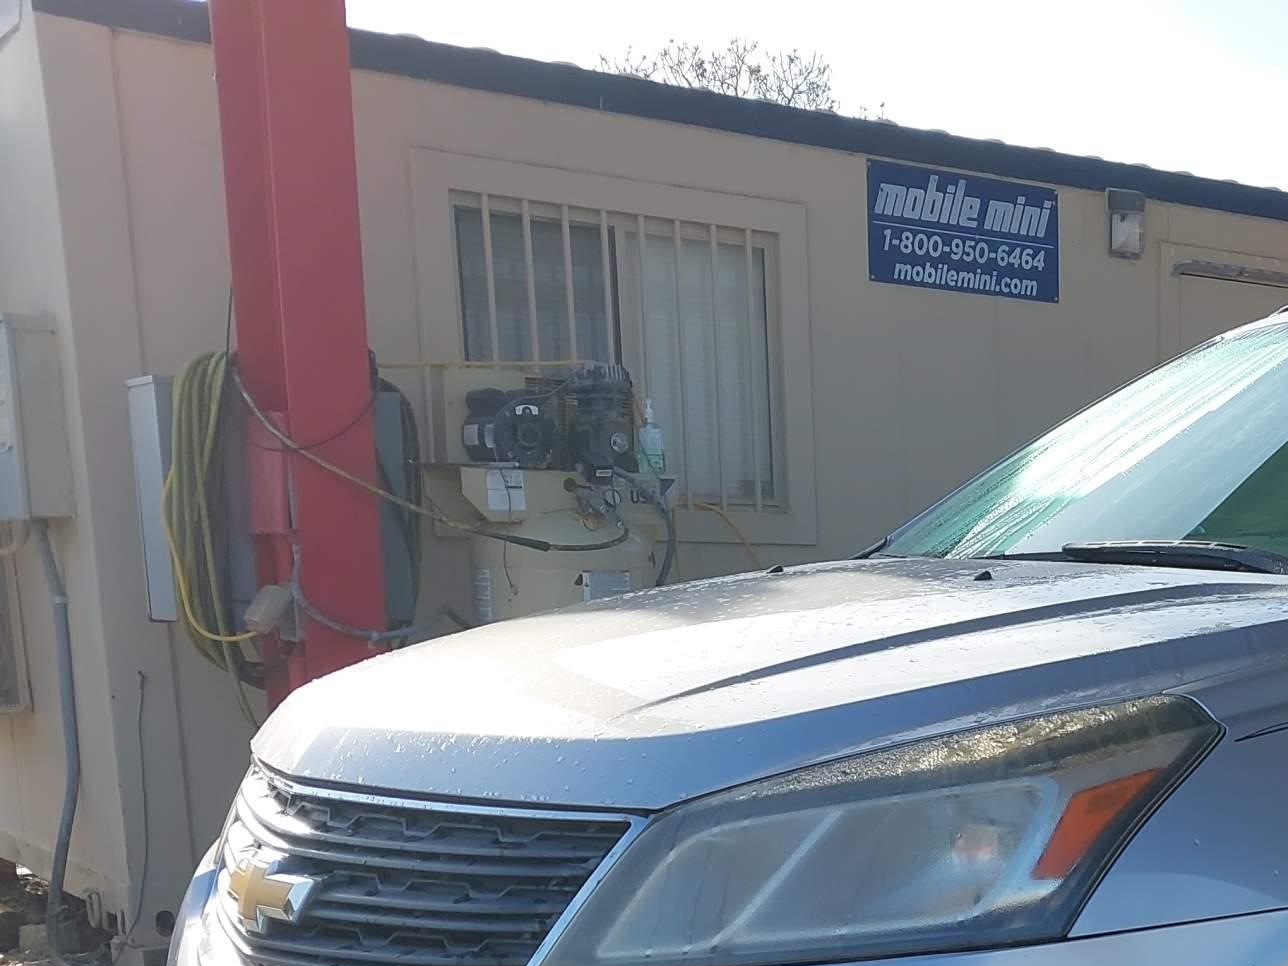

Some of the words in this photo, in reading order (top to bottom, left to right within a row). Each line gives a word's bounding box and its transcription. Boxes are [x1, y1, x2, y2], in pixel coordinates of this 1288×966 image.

[874, 175, 981, 228] mobile
[984, 196, 1052, 238] mini
[883, 229, 1045, 271] 1-800-950-6464
[893, 262, 1038, 296] mobilemini.com
